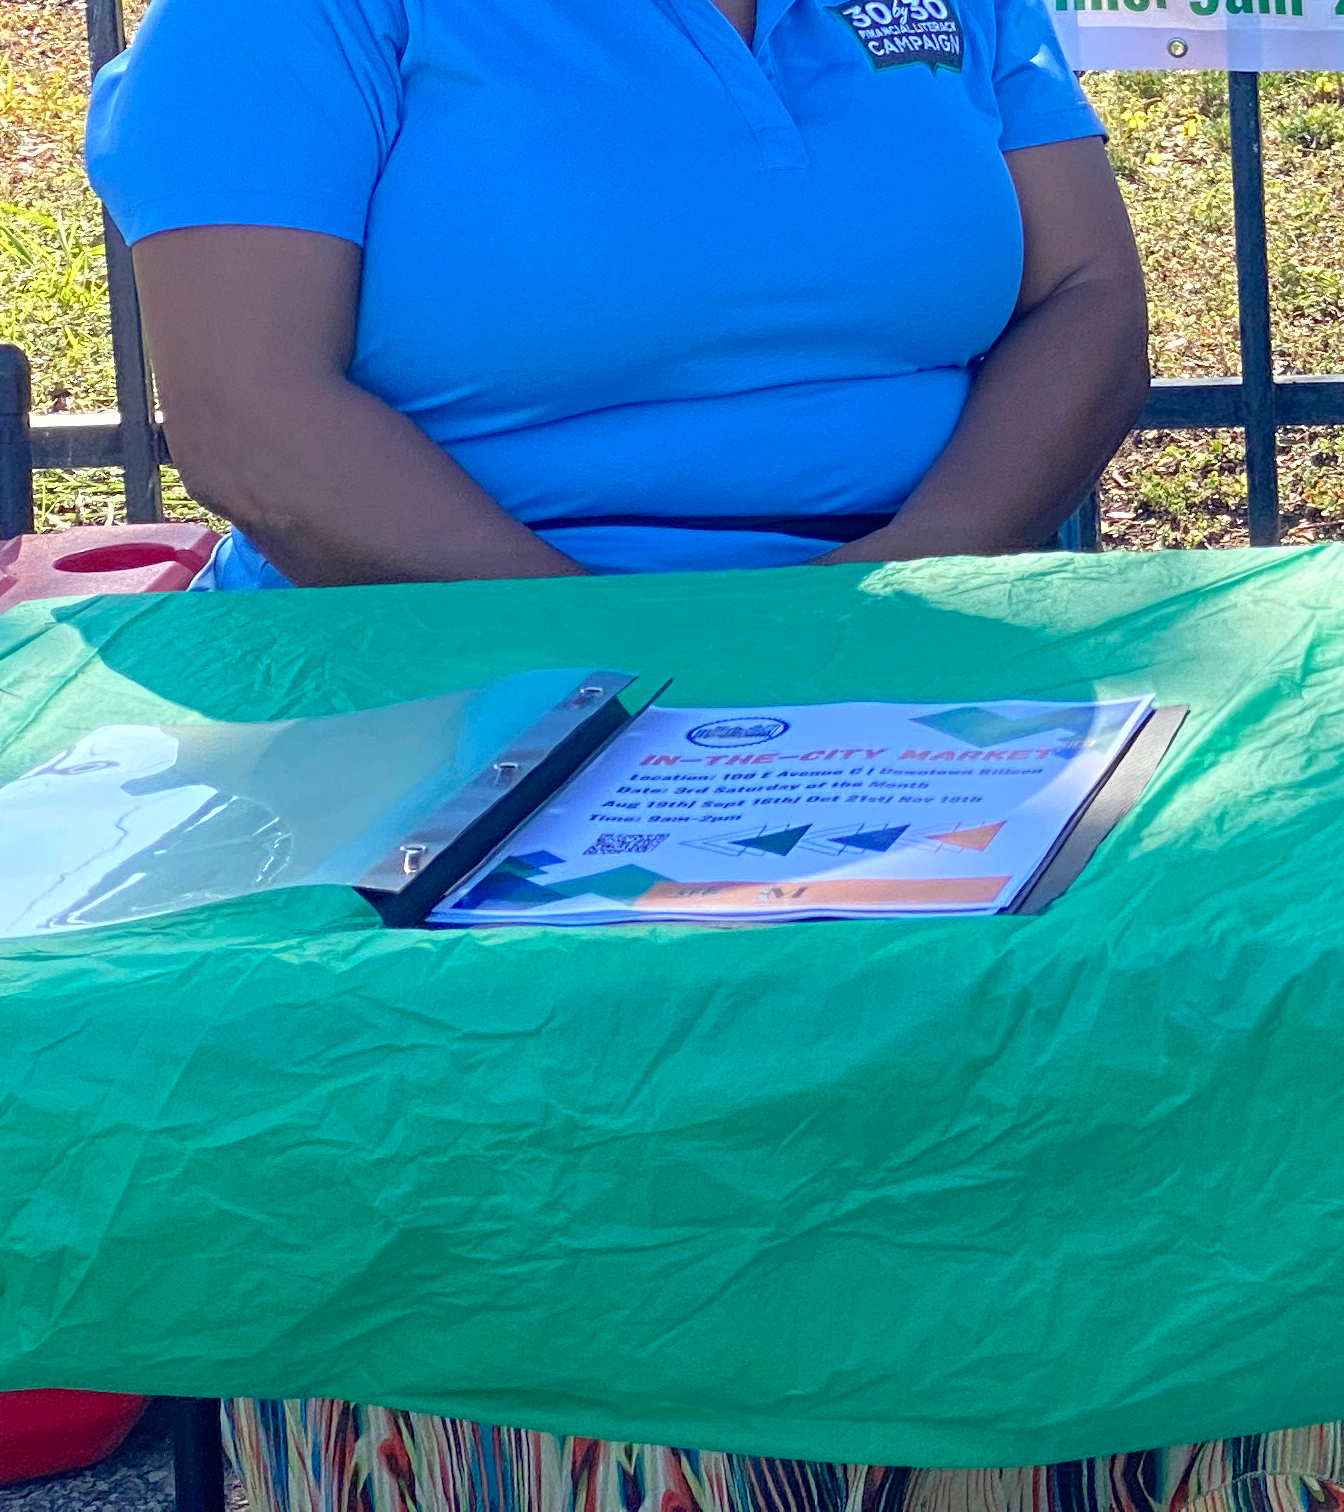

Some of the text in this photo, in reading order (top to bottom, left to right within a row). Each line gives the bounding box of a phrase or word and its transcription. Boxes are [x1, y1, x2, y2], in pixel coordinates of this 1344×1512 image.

[857, 21, 915, 40] FINANCIAL
[867, 33, 961, 56] CAMPAIGN
[640, 747, 1054, 767] IN-THE-CITY MARKET
[629, 773, 718, 782] Location:
[776, 769, 844, 778] Avenue
[616, 779, 931, 795] Date: 3rd Saturday of the Month
[600, 799, 642, 810] Aug
[700, 799, 747, 810] Sept
[588, 813, 642, 823] Time:
